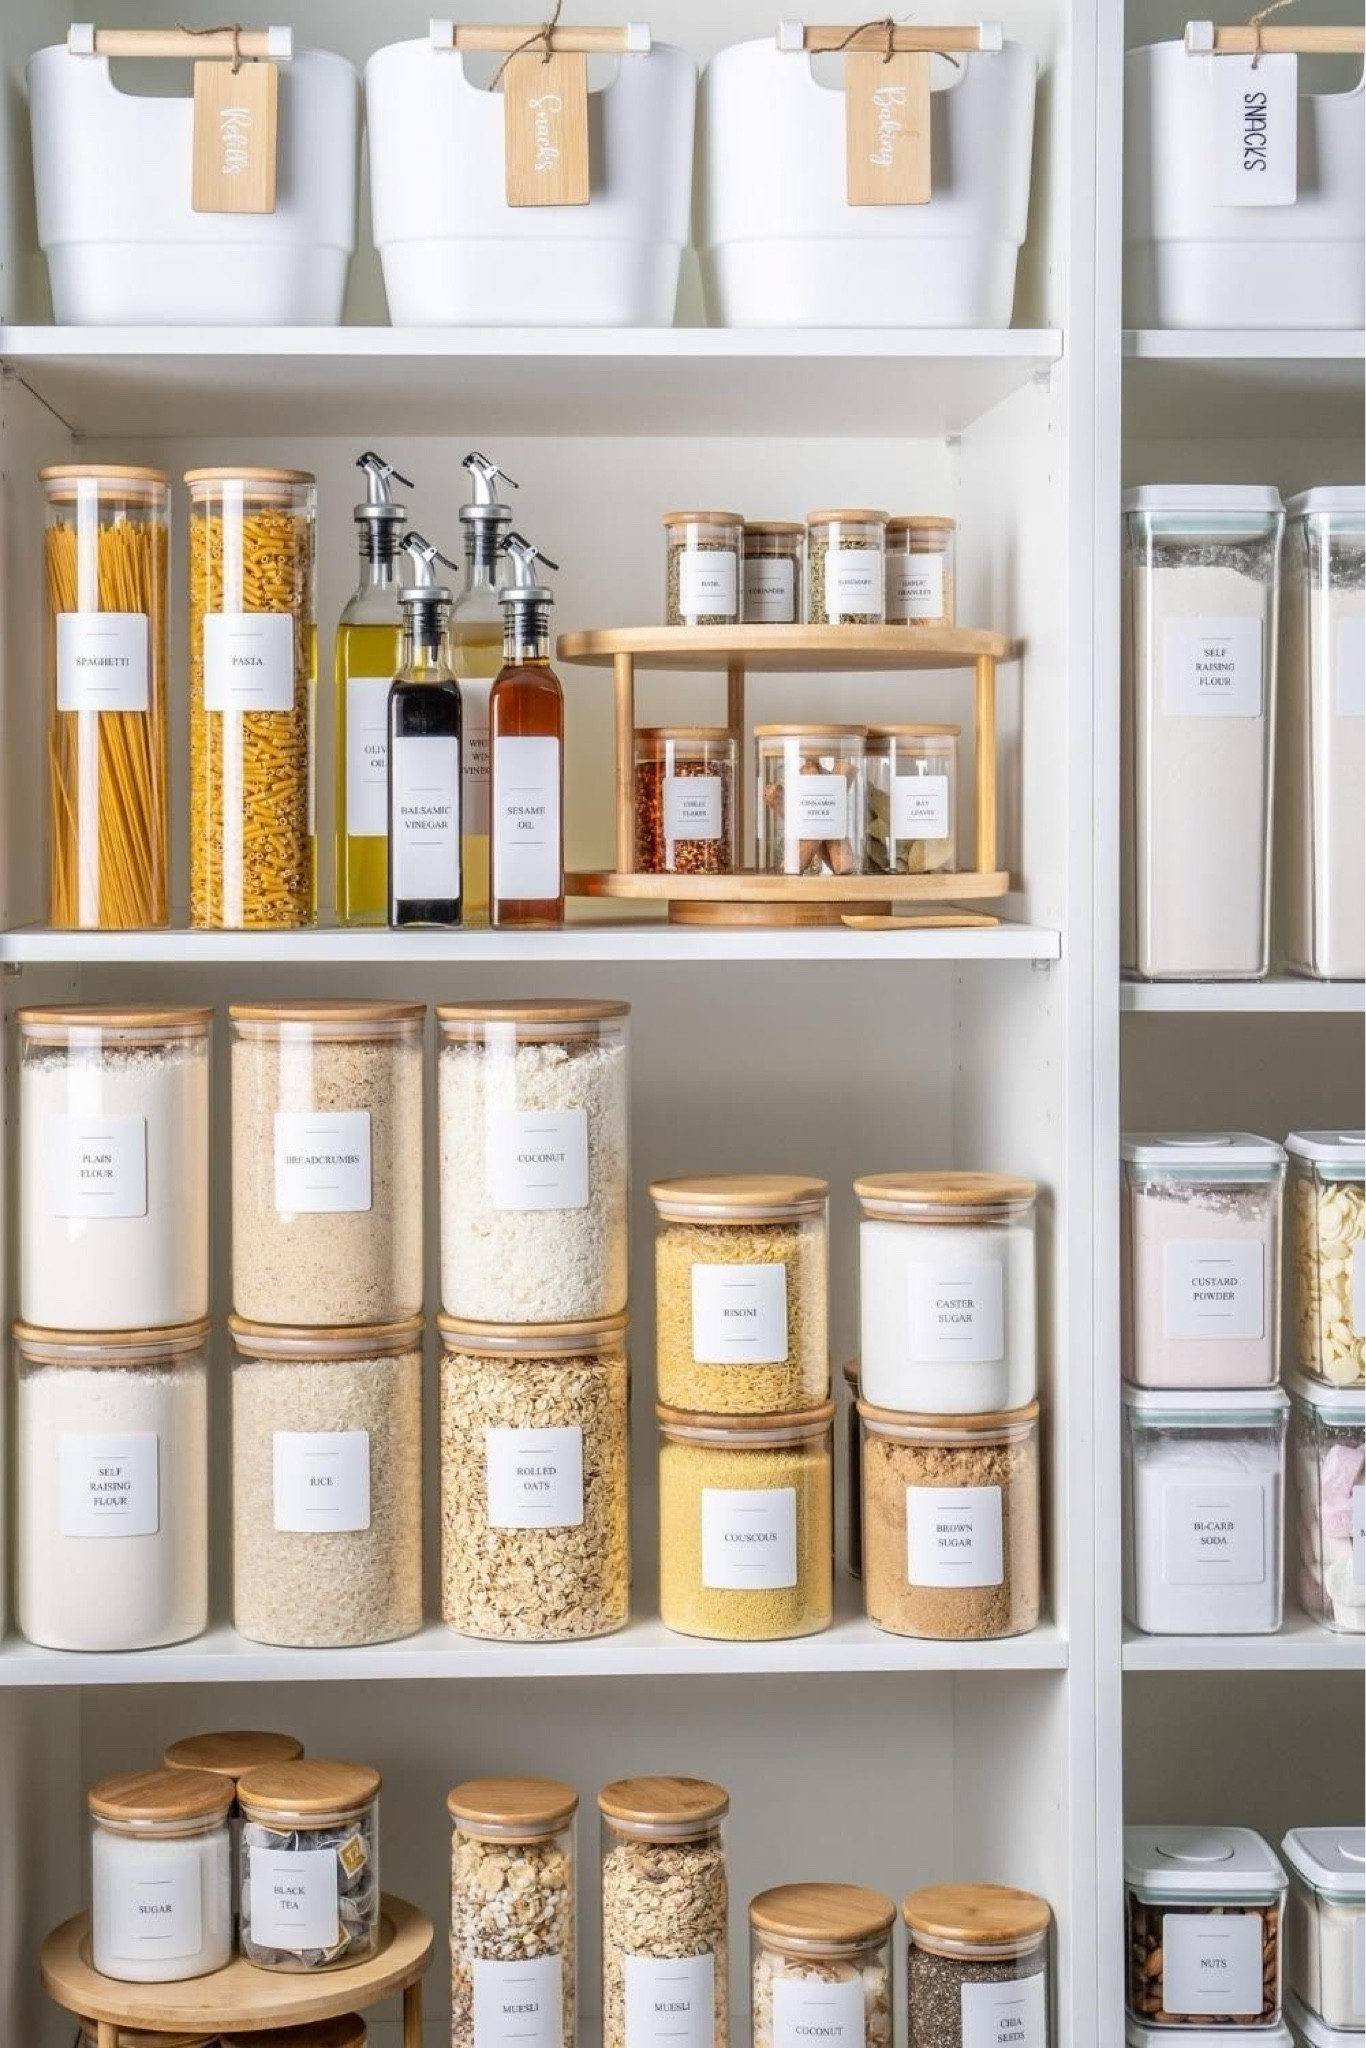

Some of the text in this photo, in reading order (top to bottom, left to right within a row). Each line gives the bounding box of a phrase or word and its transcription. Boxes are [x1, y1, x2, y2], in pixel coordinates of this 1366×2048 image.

[869, 86, 907, 165] Baking
[529, 94, 562, 172] Snacks
[1244, 92, 1267, 171] SNACKS
[220, 108, 251, 174] Refills
[1203, 648, 1226, 658] SELF
[75, 657, 129, 667] SPAGHETTI
[232, 657, 264, 666] PASTA
[1195, 662, 1235, 672] RAISING
[1199, 677, 1231, 686] FLOUR
[364, 745, 386, 755] OLIV
[400, 806, 452, 815] BALSAMIC
[506, 806, 546, 816] SESAME
[404, 820, 449, 830] VINEGAR
[517, 821, 535, 830] OIL
[82, 1154, 112, 1164] PLAIN
[286, 1154, 360, 1165] BREADCRUMBS
[517, 1153, 566, 1163] COCONUT
[80, 1169, 115, 1178] FLOUR
[1191, 1277, 1238, 1287] CUSTARD
[1193, 1291, 1235, 1301] POWDER
[935, 1299, 975, 1309] CASTER
[723, 1308, 757, 1317] RISONI
[938, 1314, 973, 1323] SUGAR
[99, 1467, 123, 1477] SELF
[516, 1466, 557, 1476] ROLLED
[90, 1482, 131, 1492] RAISING
[310, 1477, 334, 1487] RICE
[523, 1481, 550, 1491] OATS
[93, 1496, 128, 1506] FLOUR
[936, 1524, 973, 1533] BROWN
[1193, 1521, 1235, 1531] BI-CARB
[724, 1533, 778, 1543] COUSCOUS
[938, 1538, 972, 1548] SUGAR
[1200, 1536, 1228, 1545] SODA
[273, 1886, 306, 1896] BLACK
[138, 1904, 172, 1914] SUGAR
[279, 1899, 299, 1910] TEA
[1200, 1958, 1227, 1969] NUTS
[502, 2002, 539, 2014] MUESLI
[654, 2001, 691, 2012] MUESLI
[1000, 2018, 1022, 2029] CHIA
[795, 2026, 844, 2036] COCONUT
[997, 2031, 1025, 2043] SEEDS
